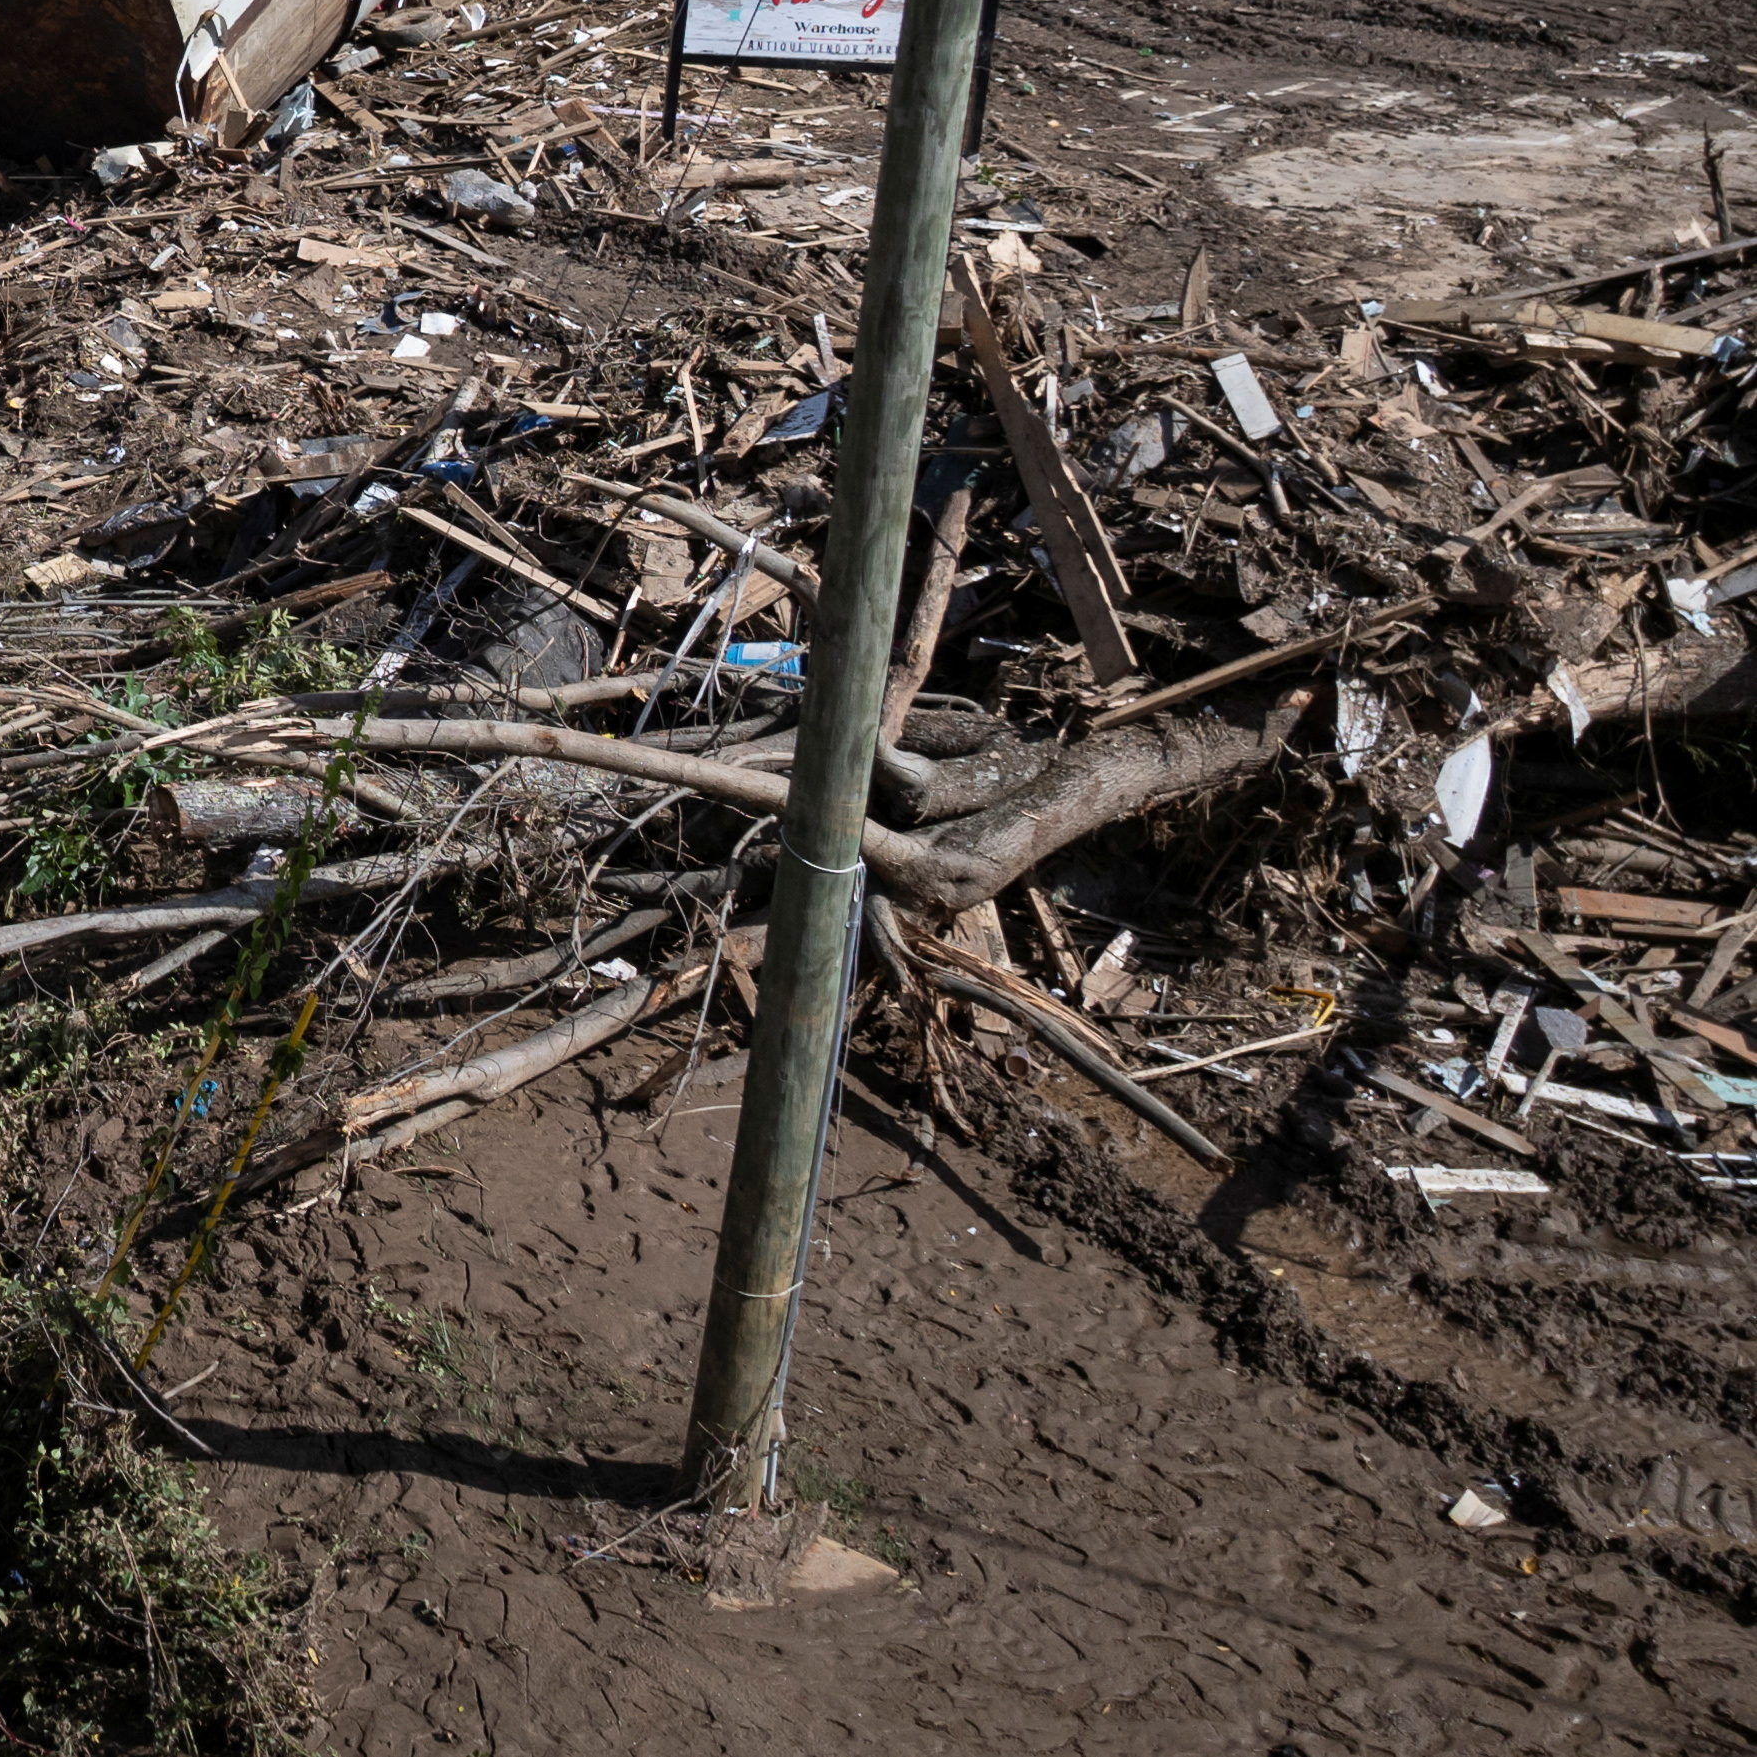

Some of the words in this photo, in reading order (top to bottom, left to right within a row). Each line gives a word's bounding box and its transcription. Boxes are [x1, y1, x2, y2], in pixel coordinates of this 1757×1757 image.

[794, 21, 880, 36] Warehouse
[747, 39, 802, 53] ANTIQUE
[809, 42, 858, 55] VENDOR
